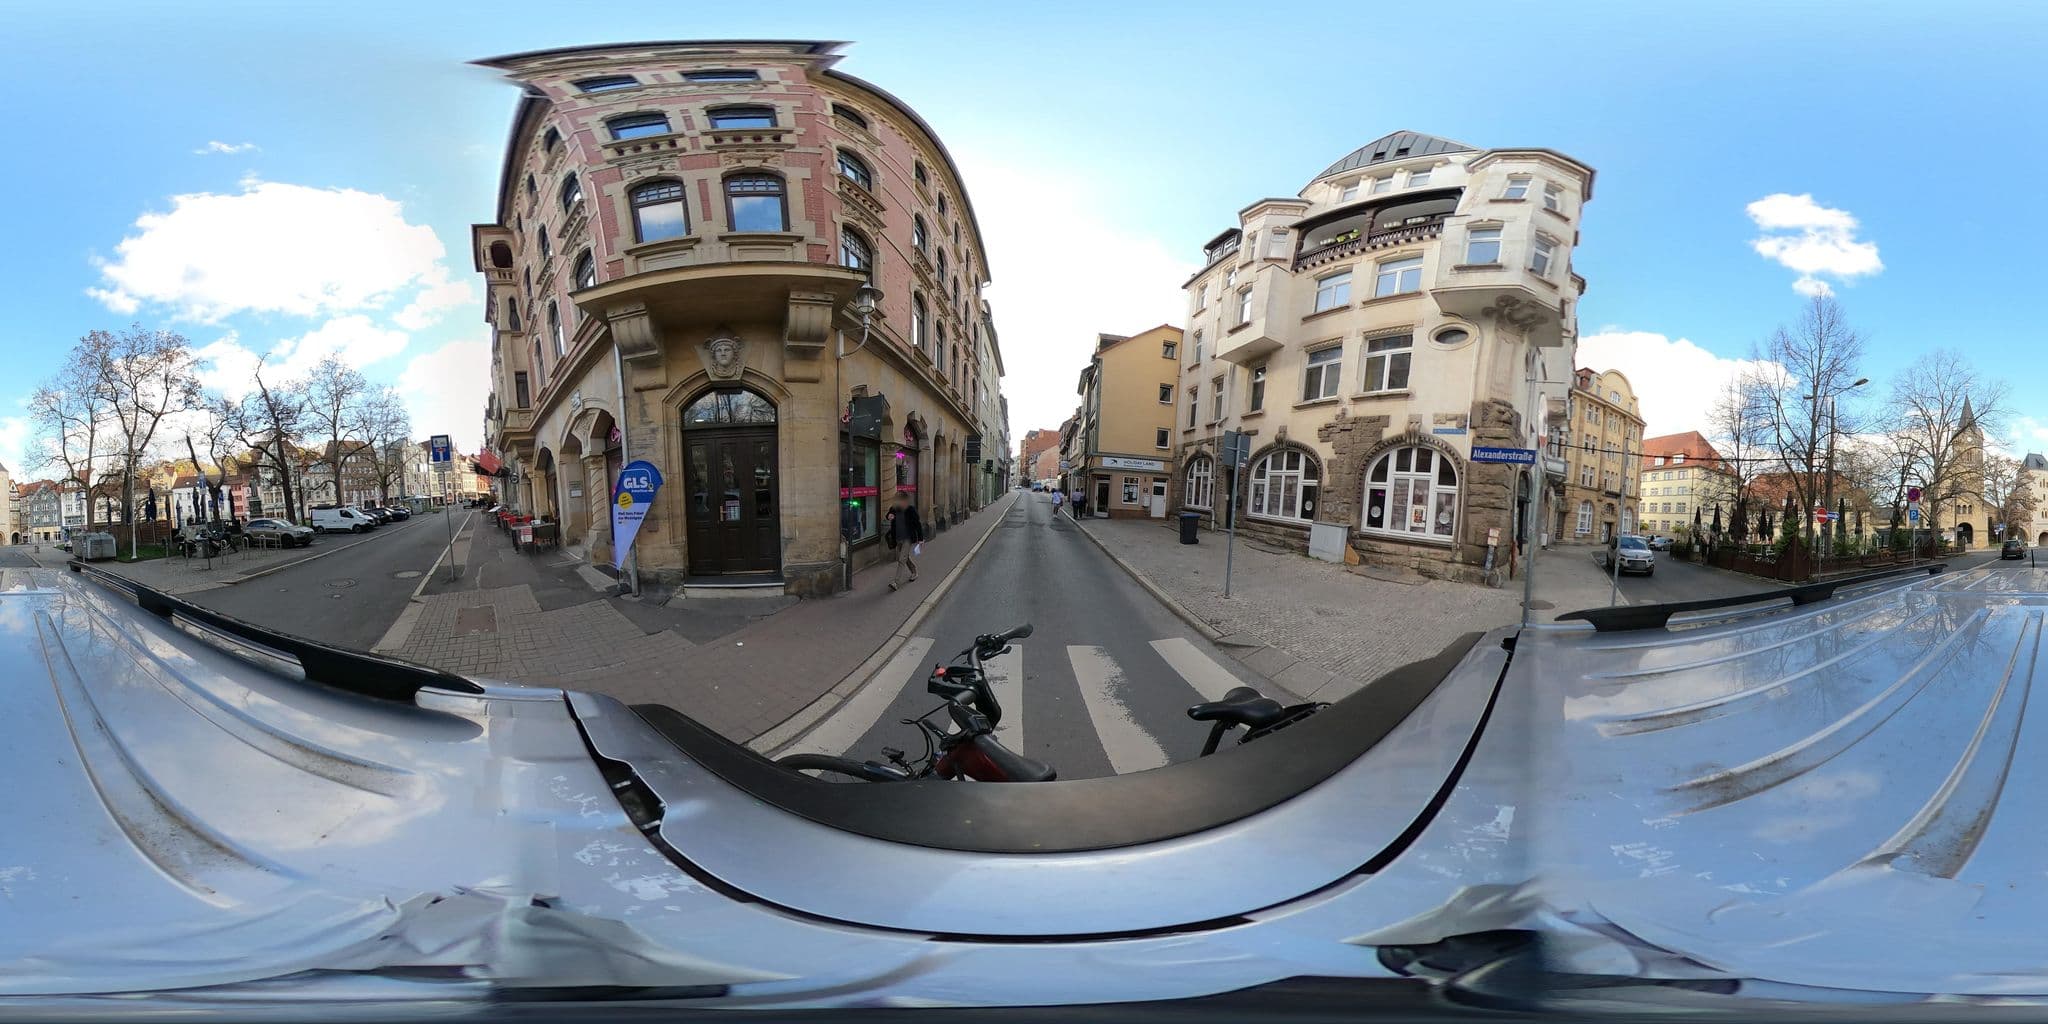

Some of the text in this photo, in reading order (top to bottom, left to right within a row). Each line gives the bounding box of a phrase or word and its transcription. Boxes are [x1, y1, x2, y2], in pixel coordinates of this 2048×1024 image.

[1472, 448, 1533, 461] Alexanderstraße
[623, 476, 648, 489] GLS
[1910, 510, 1917, 519] P
